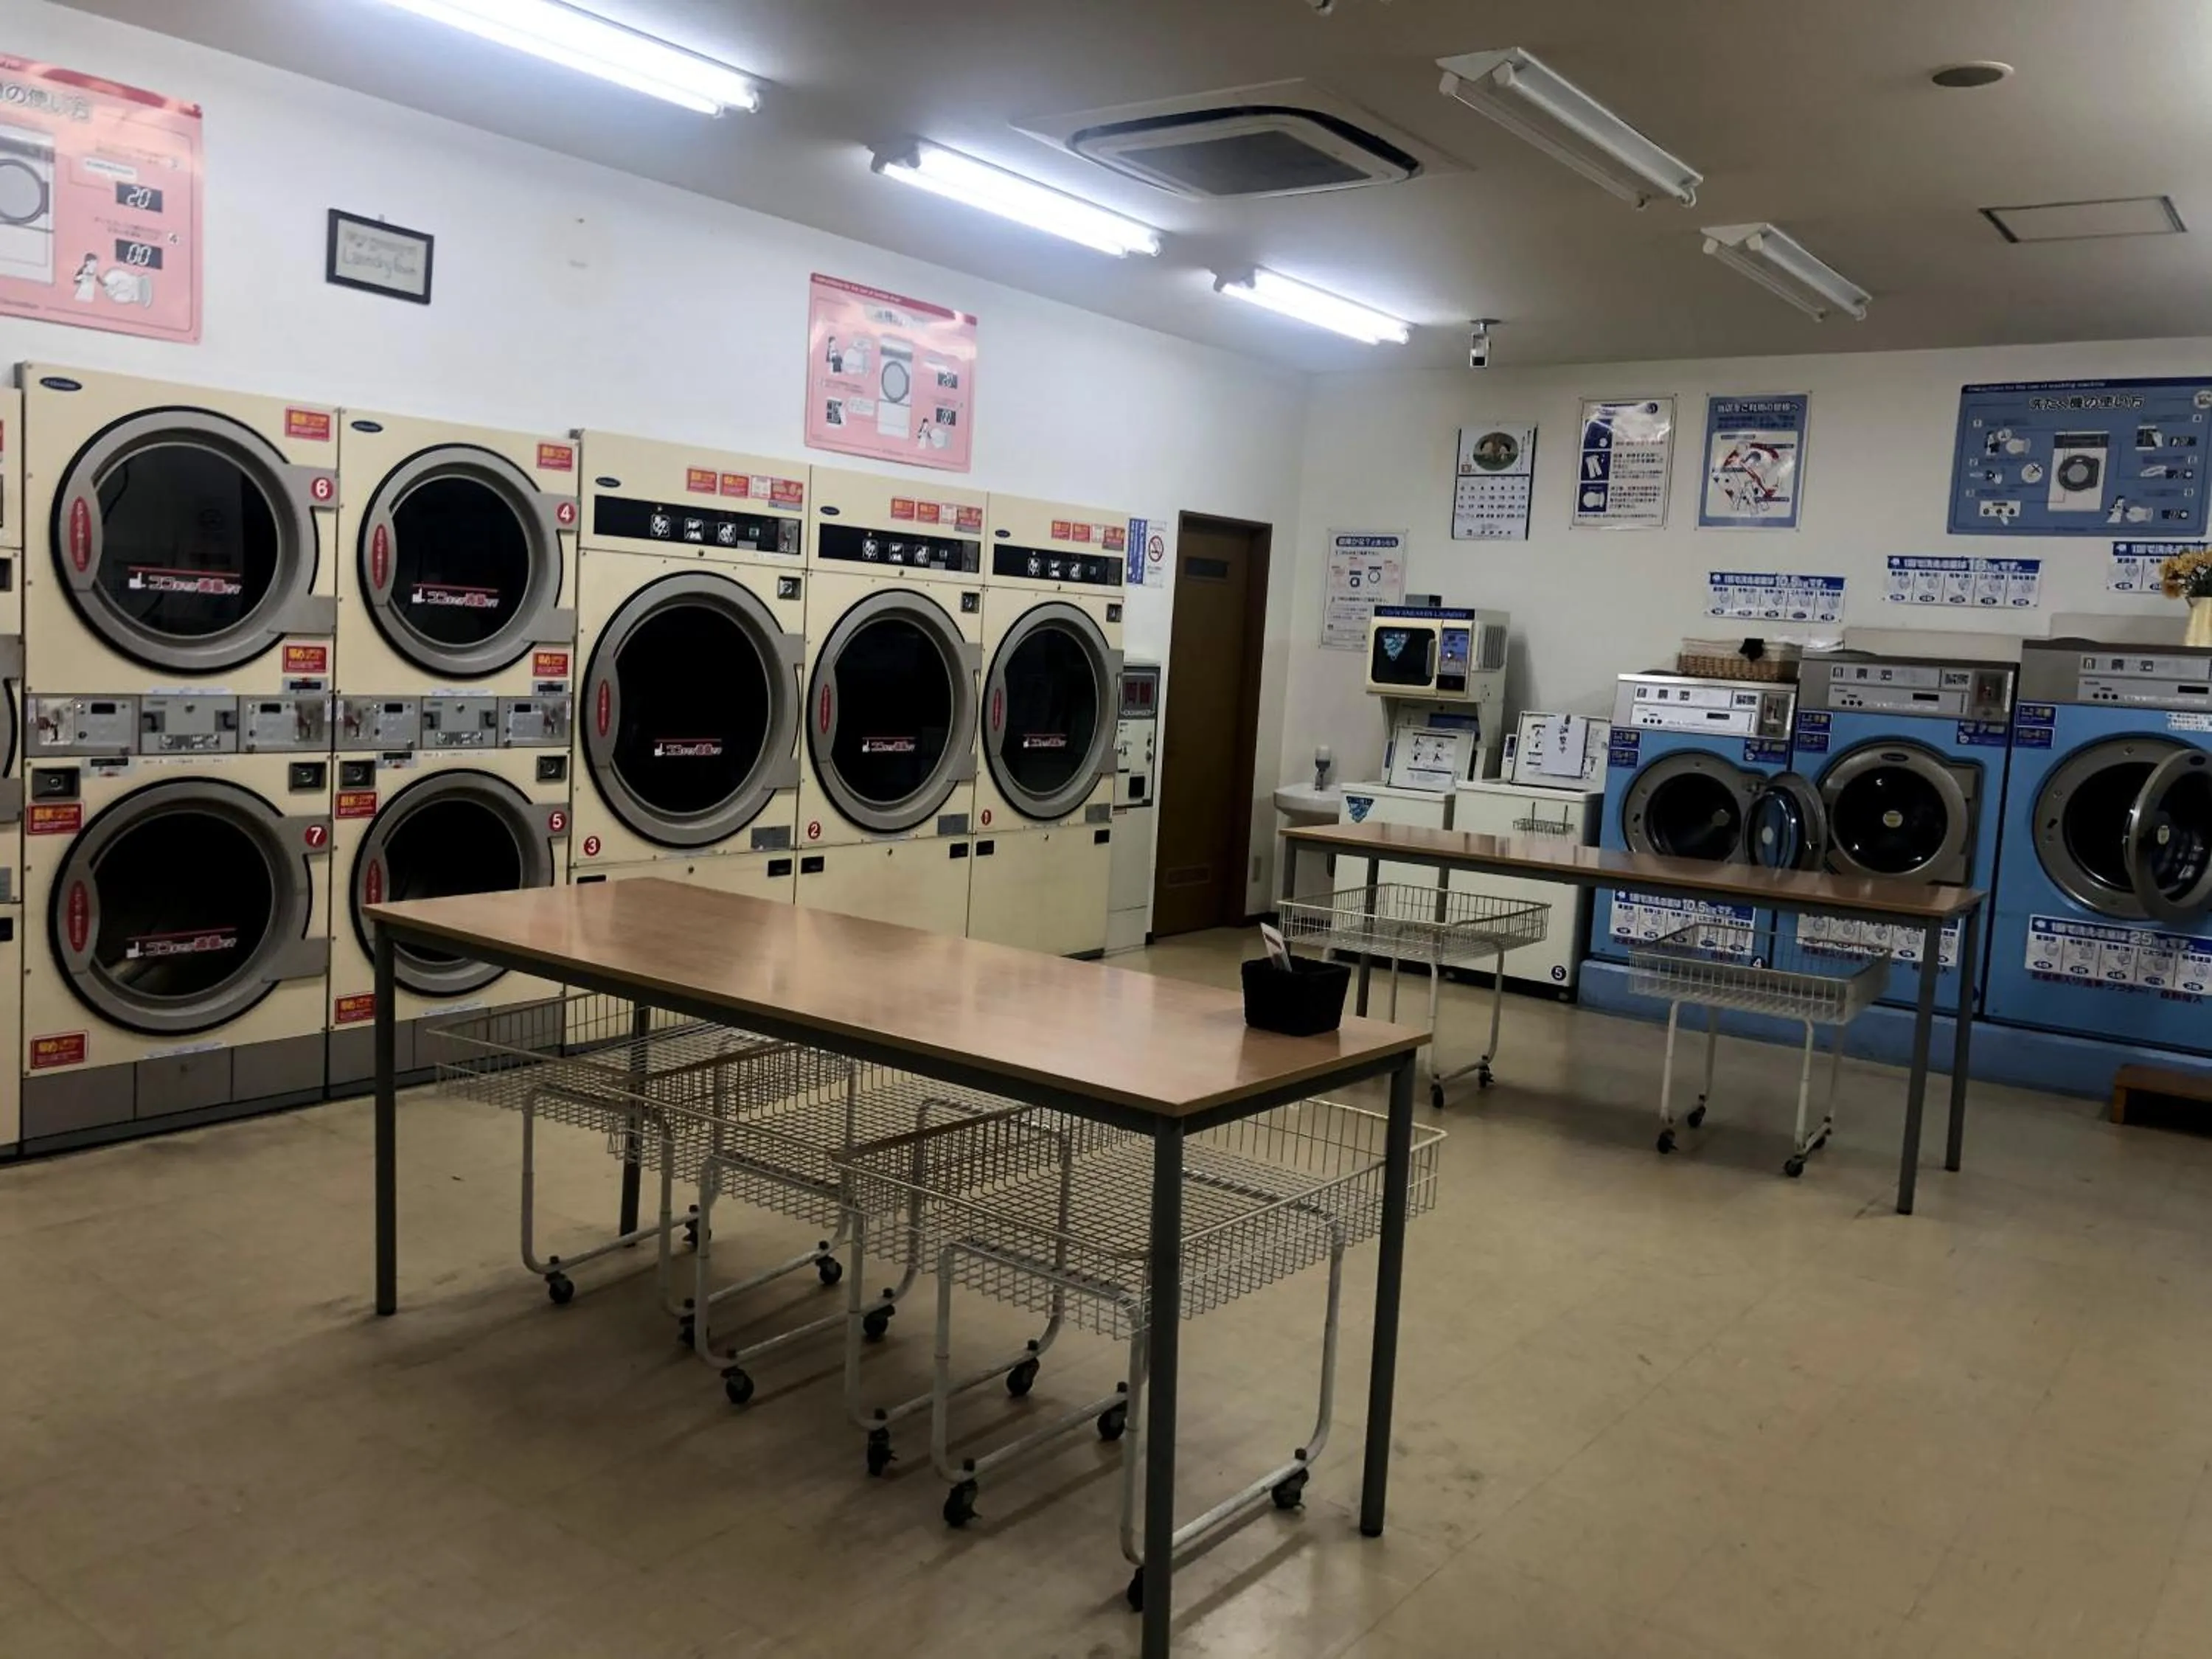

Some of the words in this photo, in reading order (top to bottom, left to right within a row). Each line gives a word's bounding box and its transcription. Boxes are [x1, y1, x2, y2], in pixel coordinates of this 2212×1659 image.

[316, 479, 328, 498] 6
[560, 506, 571, 521] 4
[553, 814, 562, 829] 5
[311, 827, 321, 844] 7
[811, 824, 818, 837] 2
[588, 839, 597, 853] 3
[1555, 967, 1562, 978] 5
